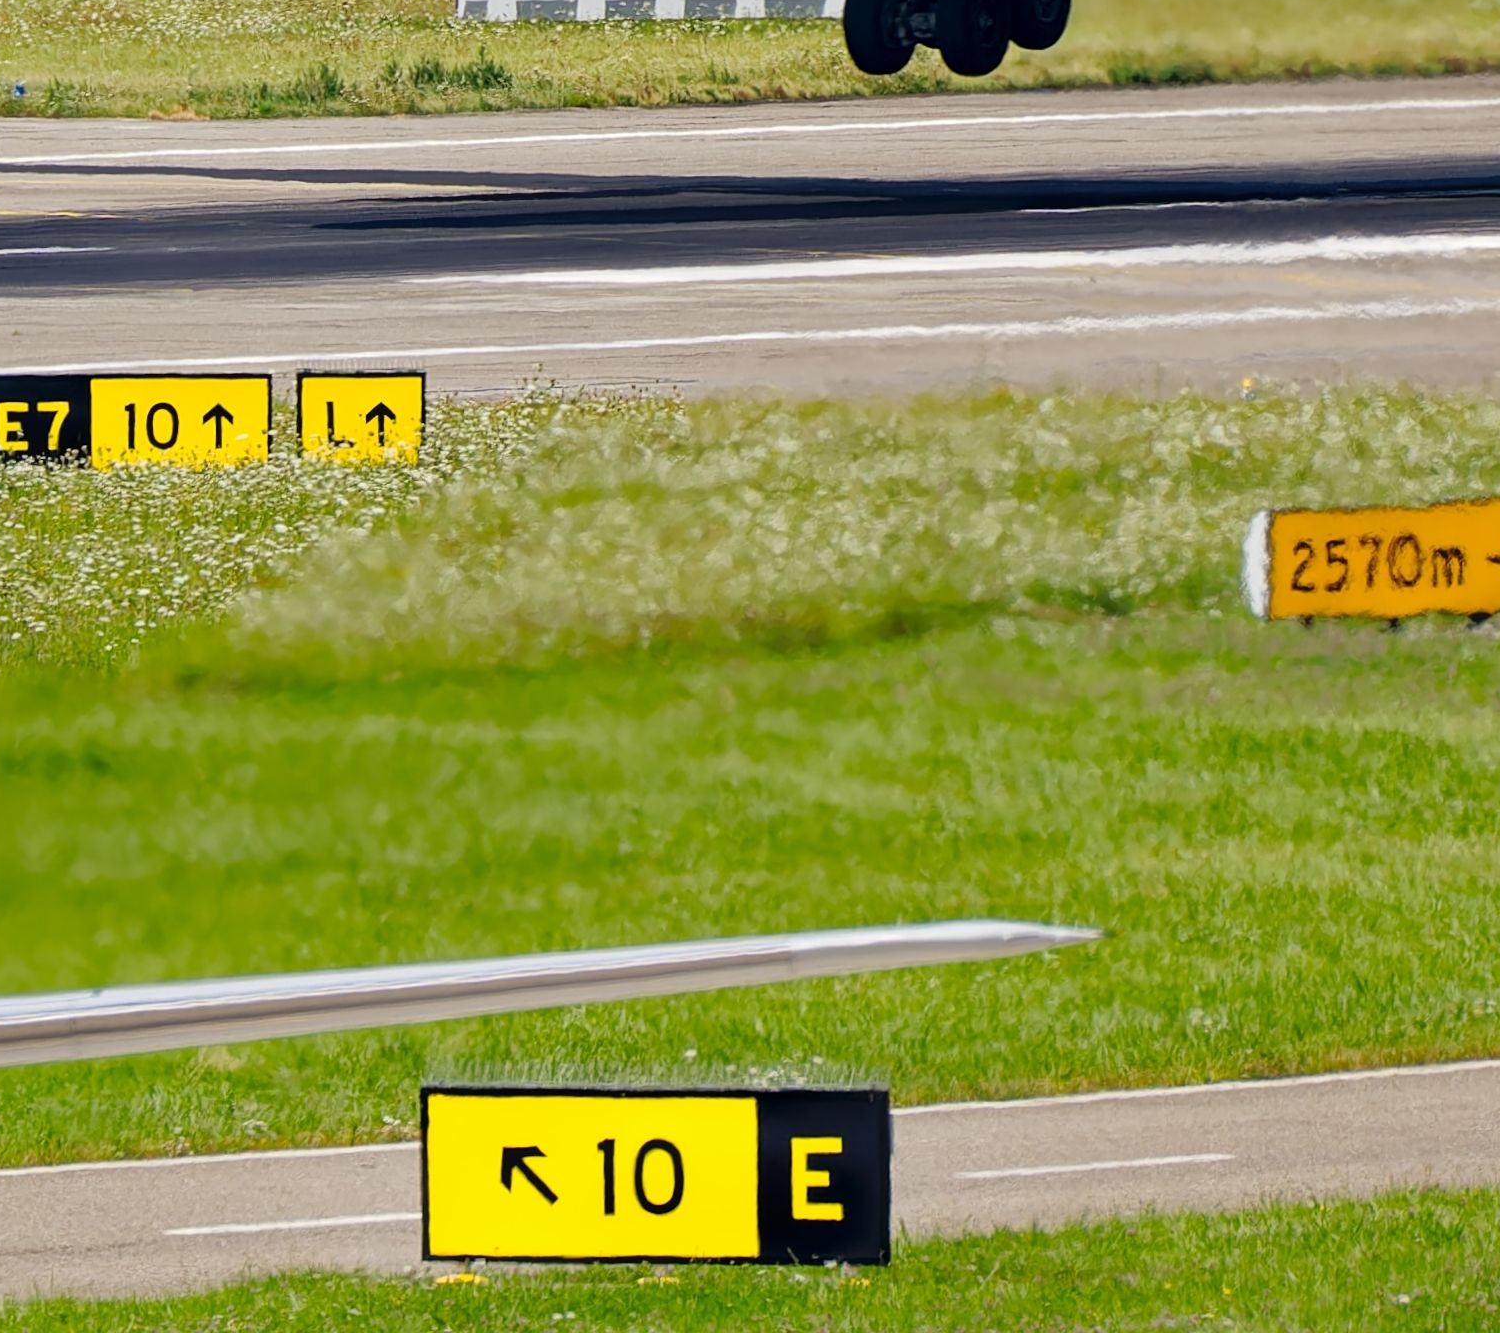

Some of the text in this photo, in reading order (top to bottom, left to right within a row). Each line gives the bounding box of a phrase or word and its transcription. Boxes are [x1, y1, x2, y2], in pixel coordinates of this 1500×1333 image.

[124, 401, 179, 450] 10
[326, 401, 356, 449] L
[1291, 533, 1466, 592] 2570m
[597, 1137, 844, 1221] 10 E
